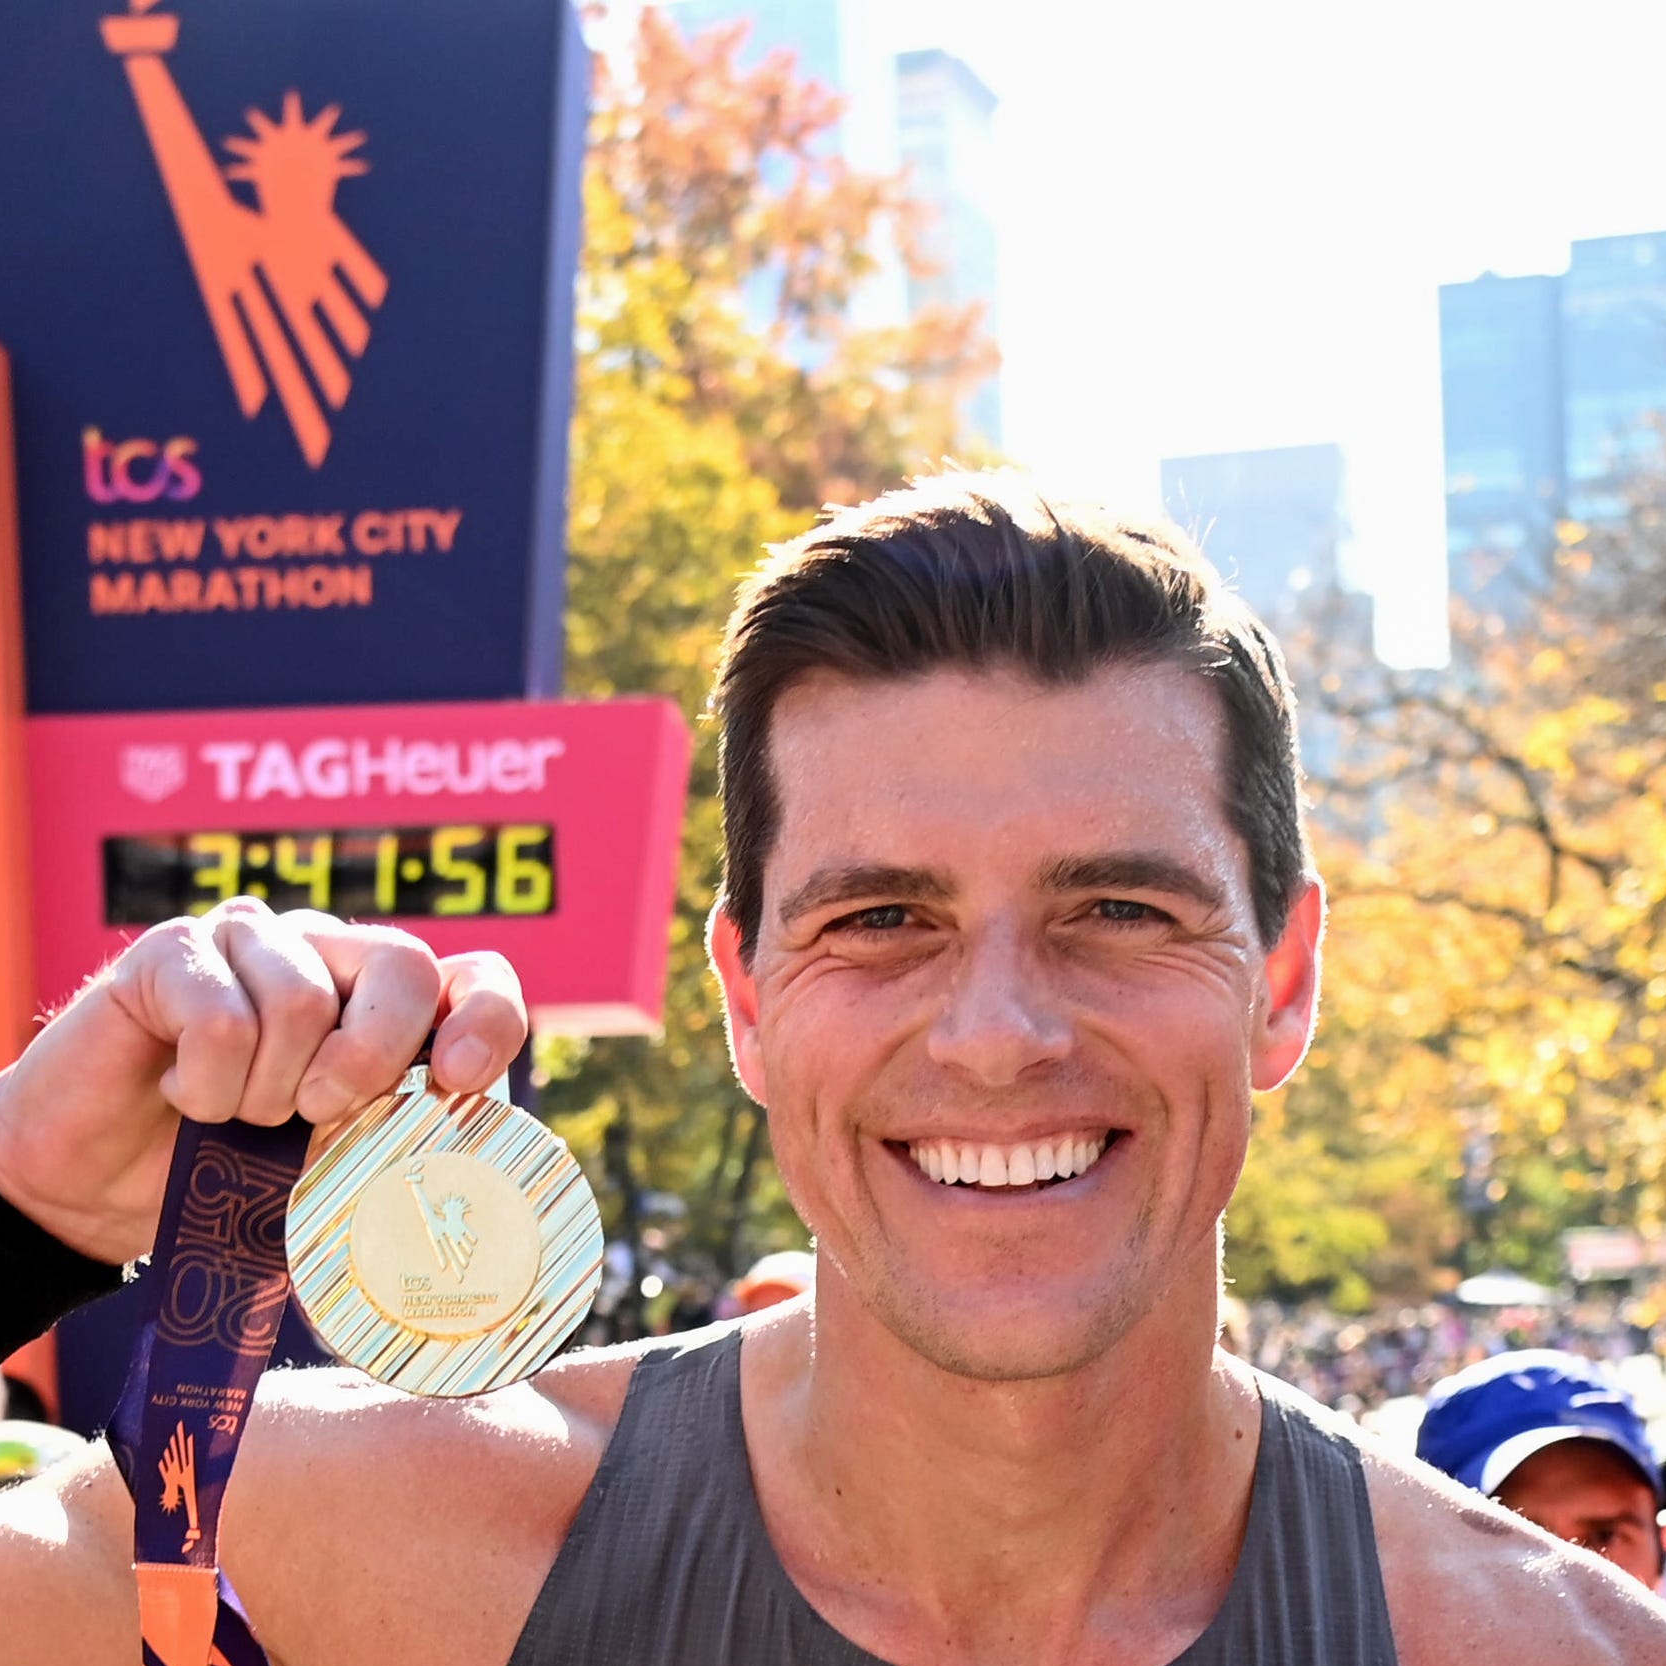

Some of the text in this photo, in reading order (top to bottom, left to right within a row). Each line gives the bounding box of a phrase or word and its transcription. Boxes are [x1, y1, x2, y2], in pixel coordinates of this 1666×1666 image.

[83, 425, 202, 503] tcs
[88, 508, 463, 564] NEW YORK CITY
[90, 564, 373, 615] MARATHON
[151, 1394, 243, 1412] NEW YORK CITY
[177, 1383, 247, 1399] MARATHON
[206, 1413, 239, 1437] tcs
